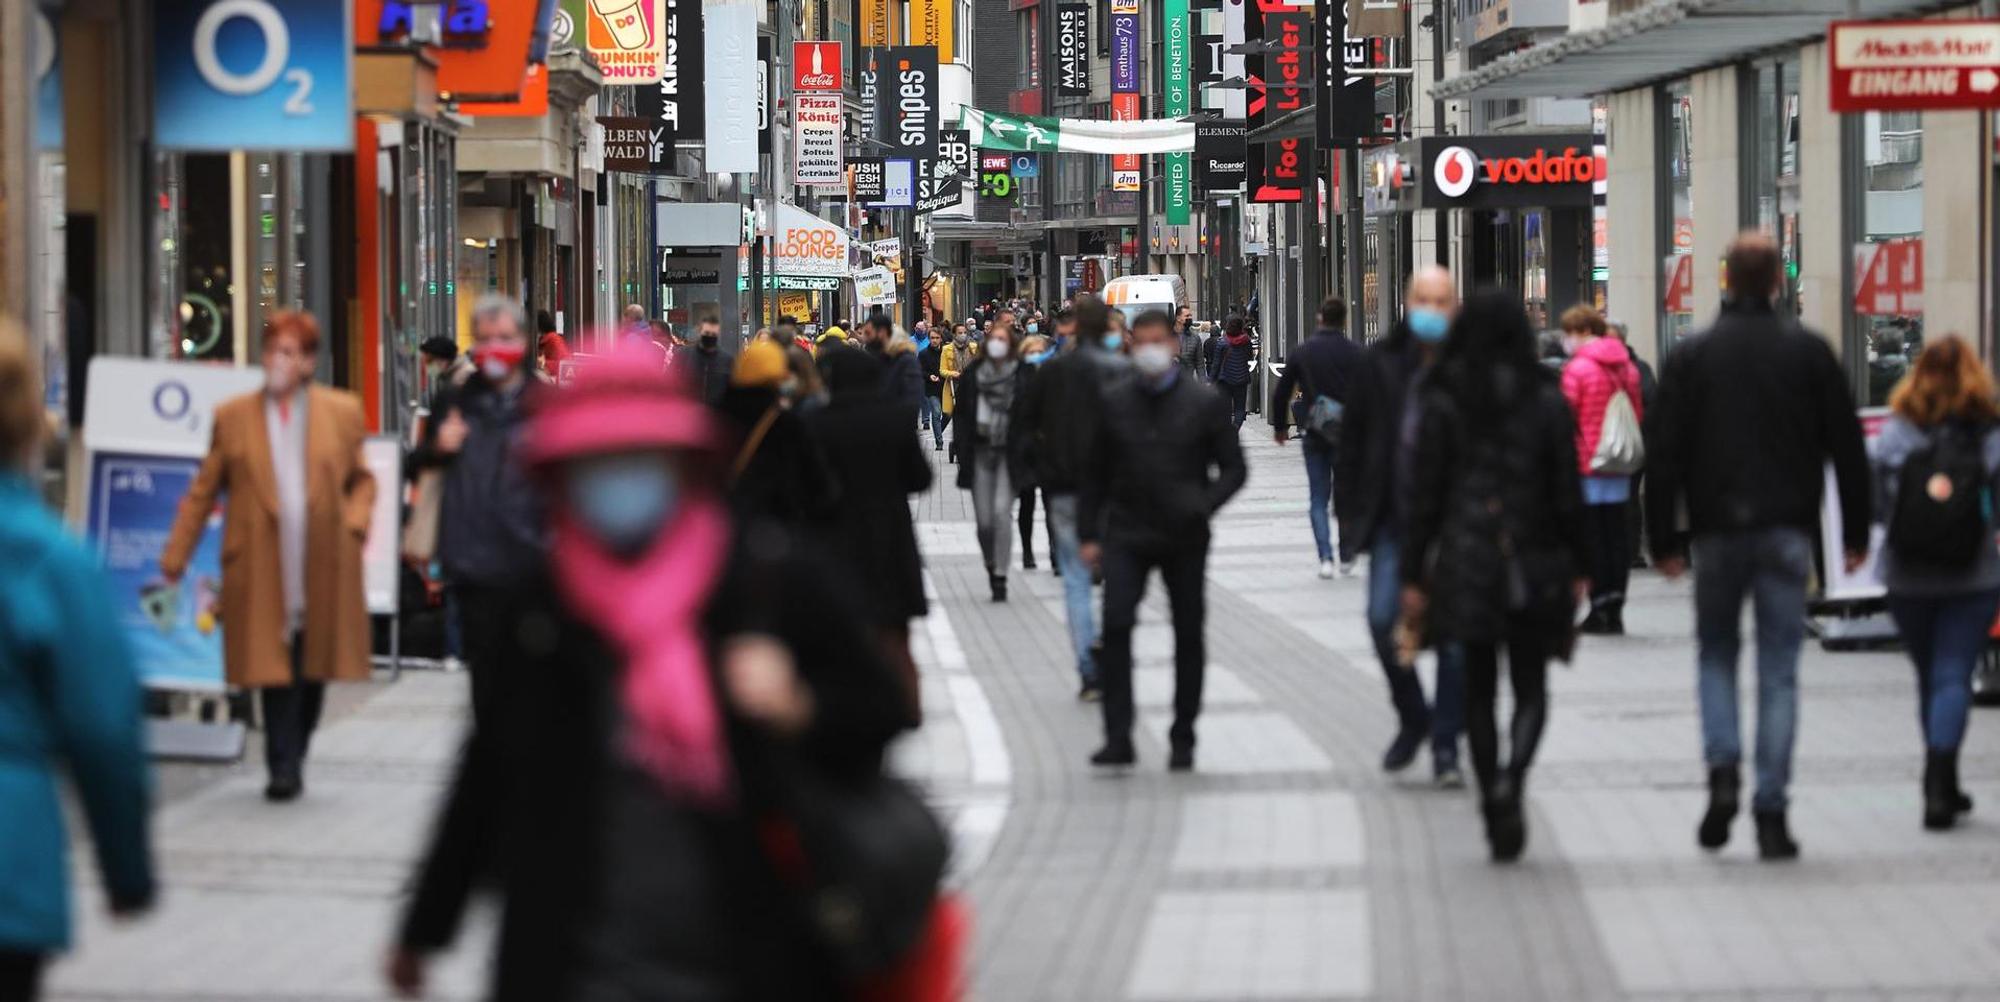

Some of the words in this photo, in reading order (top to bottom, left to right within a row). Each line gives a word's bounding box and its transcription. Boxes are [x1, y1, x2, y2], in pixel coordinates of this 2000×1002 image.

[1078, 11, 1086, 60] MONDE
[1061, 11, 1074, 88] MAISONS
[193, 0, 315, 114] O2
[601, 65, 656, 77] ONUTS
[1276, 21, 1299, 109] Locker
[1079, 72, 1086, 88] DU
[1849, 69, 1959, 96] EINGANG
[1172, 86, 1182, 102] OF
[799, 98, 837, 109] Pizza
[898, 70, 931, 146] snipes
[797, 111, 839, 124] König
[803, 129, 834, 138] Crepes
[603, 146, 645, 158] WALD
[802, 148, 834, 156] Softeis
[1275, 138, 1298, 178] Foo
[799, 158, 838, 168] gekühlte
[855, 163, 880, 173] USH
[797, 169, 839, 177] Getränke
[855, 173, 880, 183] ESH
[1118, 174, 1137, 184] dm
[1172, 163, 1183, 207] UNITED
[915, 193, 959, 210] Belgique
[786, 228, 836, 246] FOOD
[778, 242, 845, 260] LOUNGE
[781, 295, 805, 305] Coffee
[793, 304, 804, 314] go
